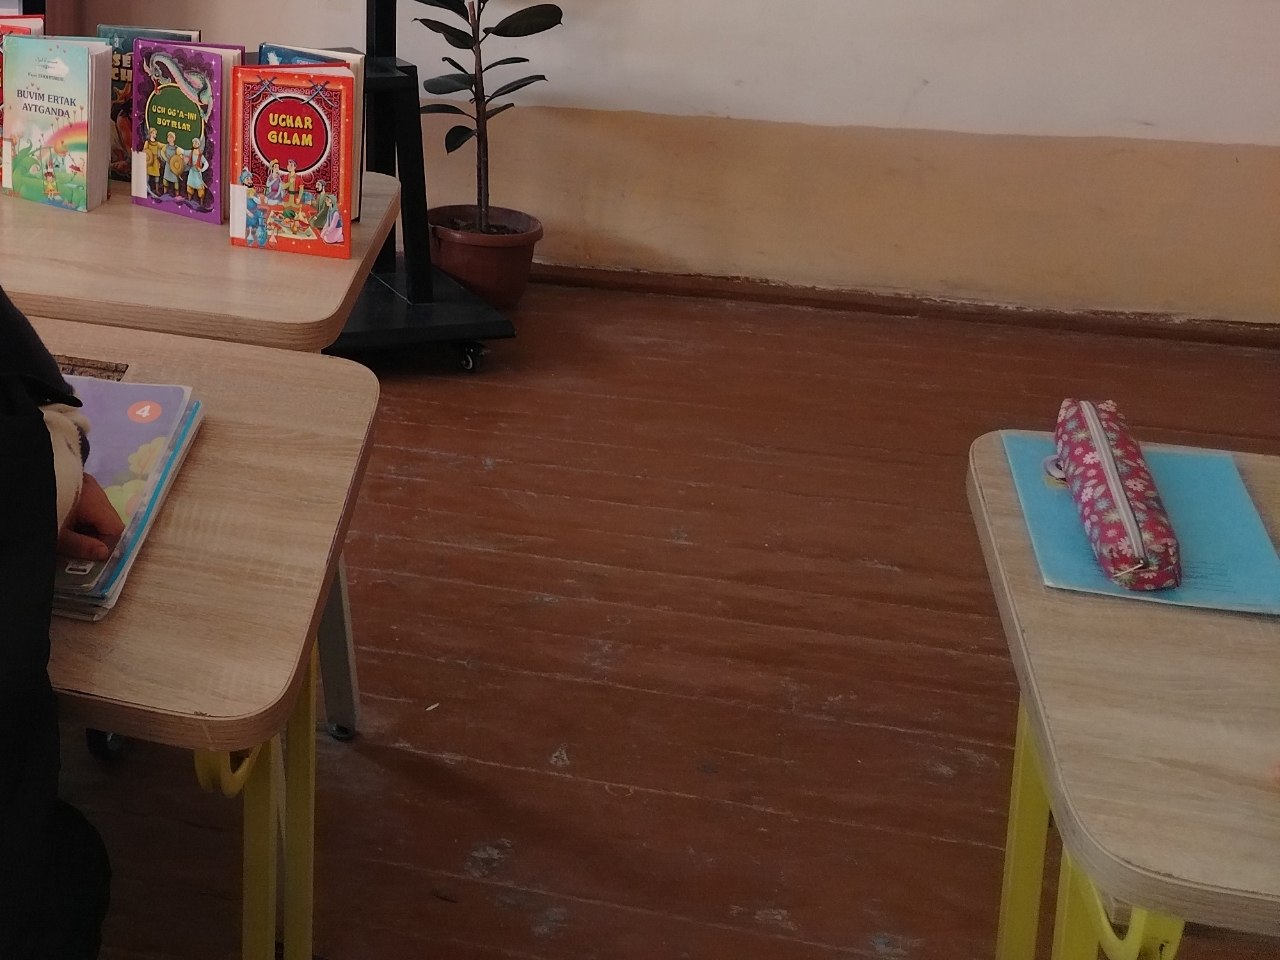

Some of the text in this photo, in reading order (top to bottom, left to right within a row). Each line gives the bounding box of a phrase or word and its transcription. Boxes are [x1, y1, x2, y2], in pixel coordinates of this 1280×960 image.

[16, 89, 77, 107] BUVIM ERTAK
[22, 102, 71, 119] AYTGANDA
[151, 105, 169, 115] UCH
[156, 117, 192, 132] BOTIRLAR
[269, 113, 313, 130] UCHAR
[267, 130, 314, 147] GILAM
[135, 404, 151, 419] 4
